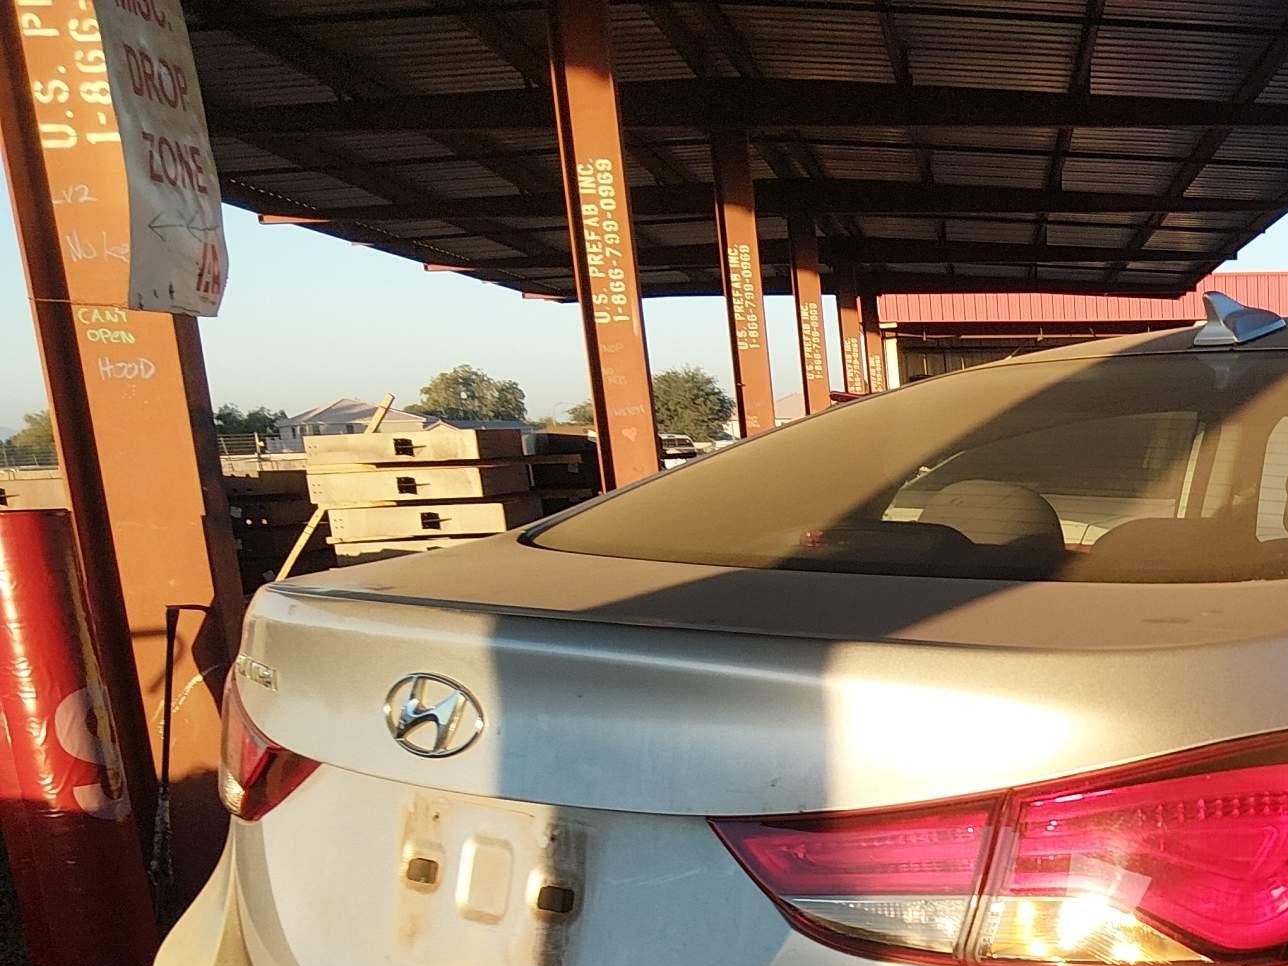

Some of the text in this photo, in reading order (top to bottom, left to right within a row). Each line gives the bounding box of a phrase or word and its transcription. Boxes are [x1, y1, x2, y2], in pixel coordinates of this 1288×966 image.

[18, 0, 78, 148] U.S. P
[122, 41, 188, 112] DROP
[142, 131, 209, 194] ZONE
[577, 158, 612, 324] U.S. PREFAB INC.
[595, 158, 630, 322] 1-866-799-0969
[730, 273, 746, 321] PREFAB
[86, 328, 137, 344] OPEN
[97, 355, 156, 380] HOOD
[736, 327, 749, 350] U.S.
